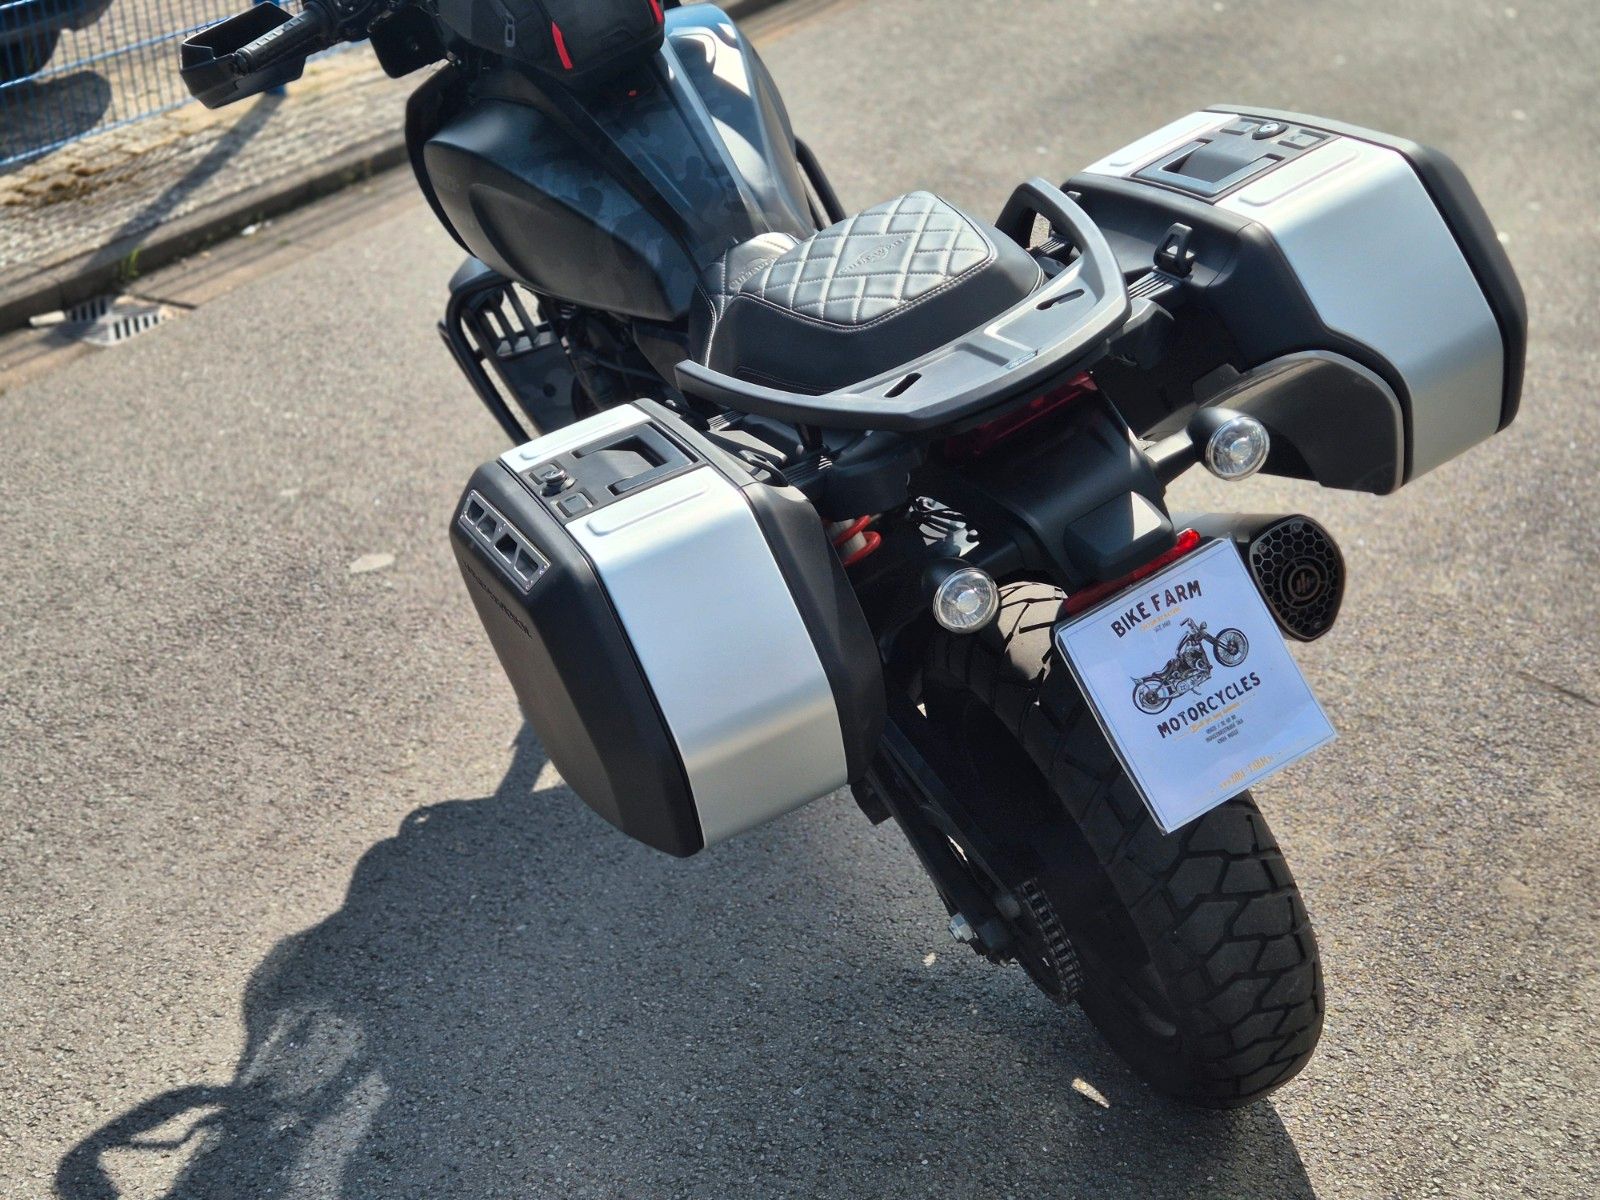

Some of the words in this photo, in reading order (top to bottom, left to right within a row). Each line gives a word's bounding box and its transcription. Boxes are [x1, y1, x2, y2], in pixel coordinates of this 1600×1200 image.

[1110, 603, 1151, 638] BIKE
[1153, 580, 1202, 612] FARM
[1157, 672, 1261, 738] MOTORCYCLES
